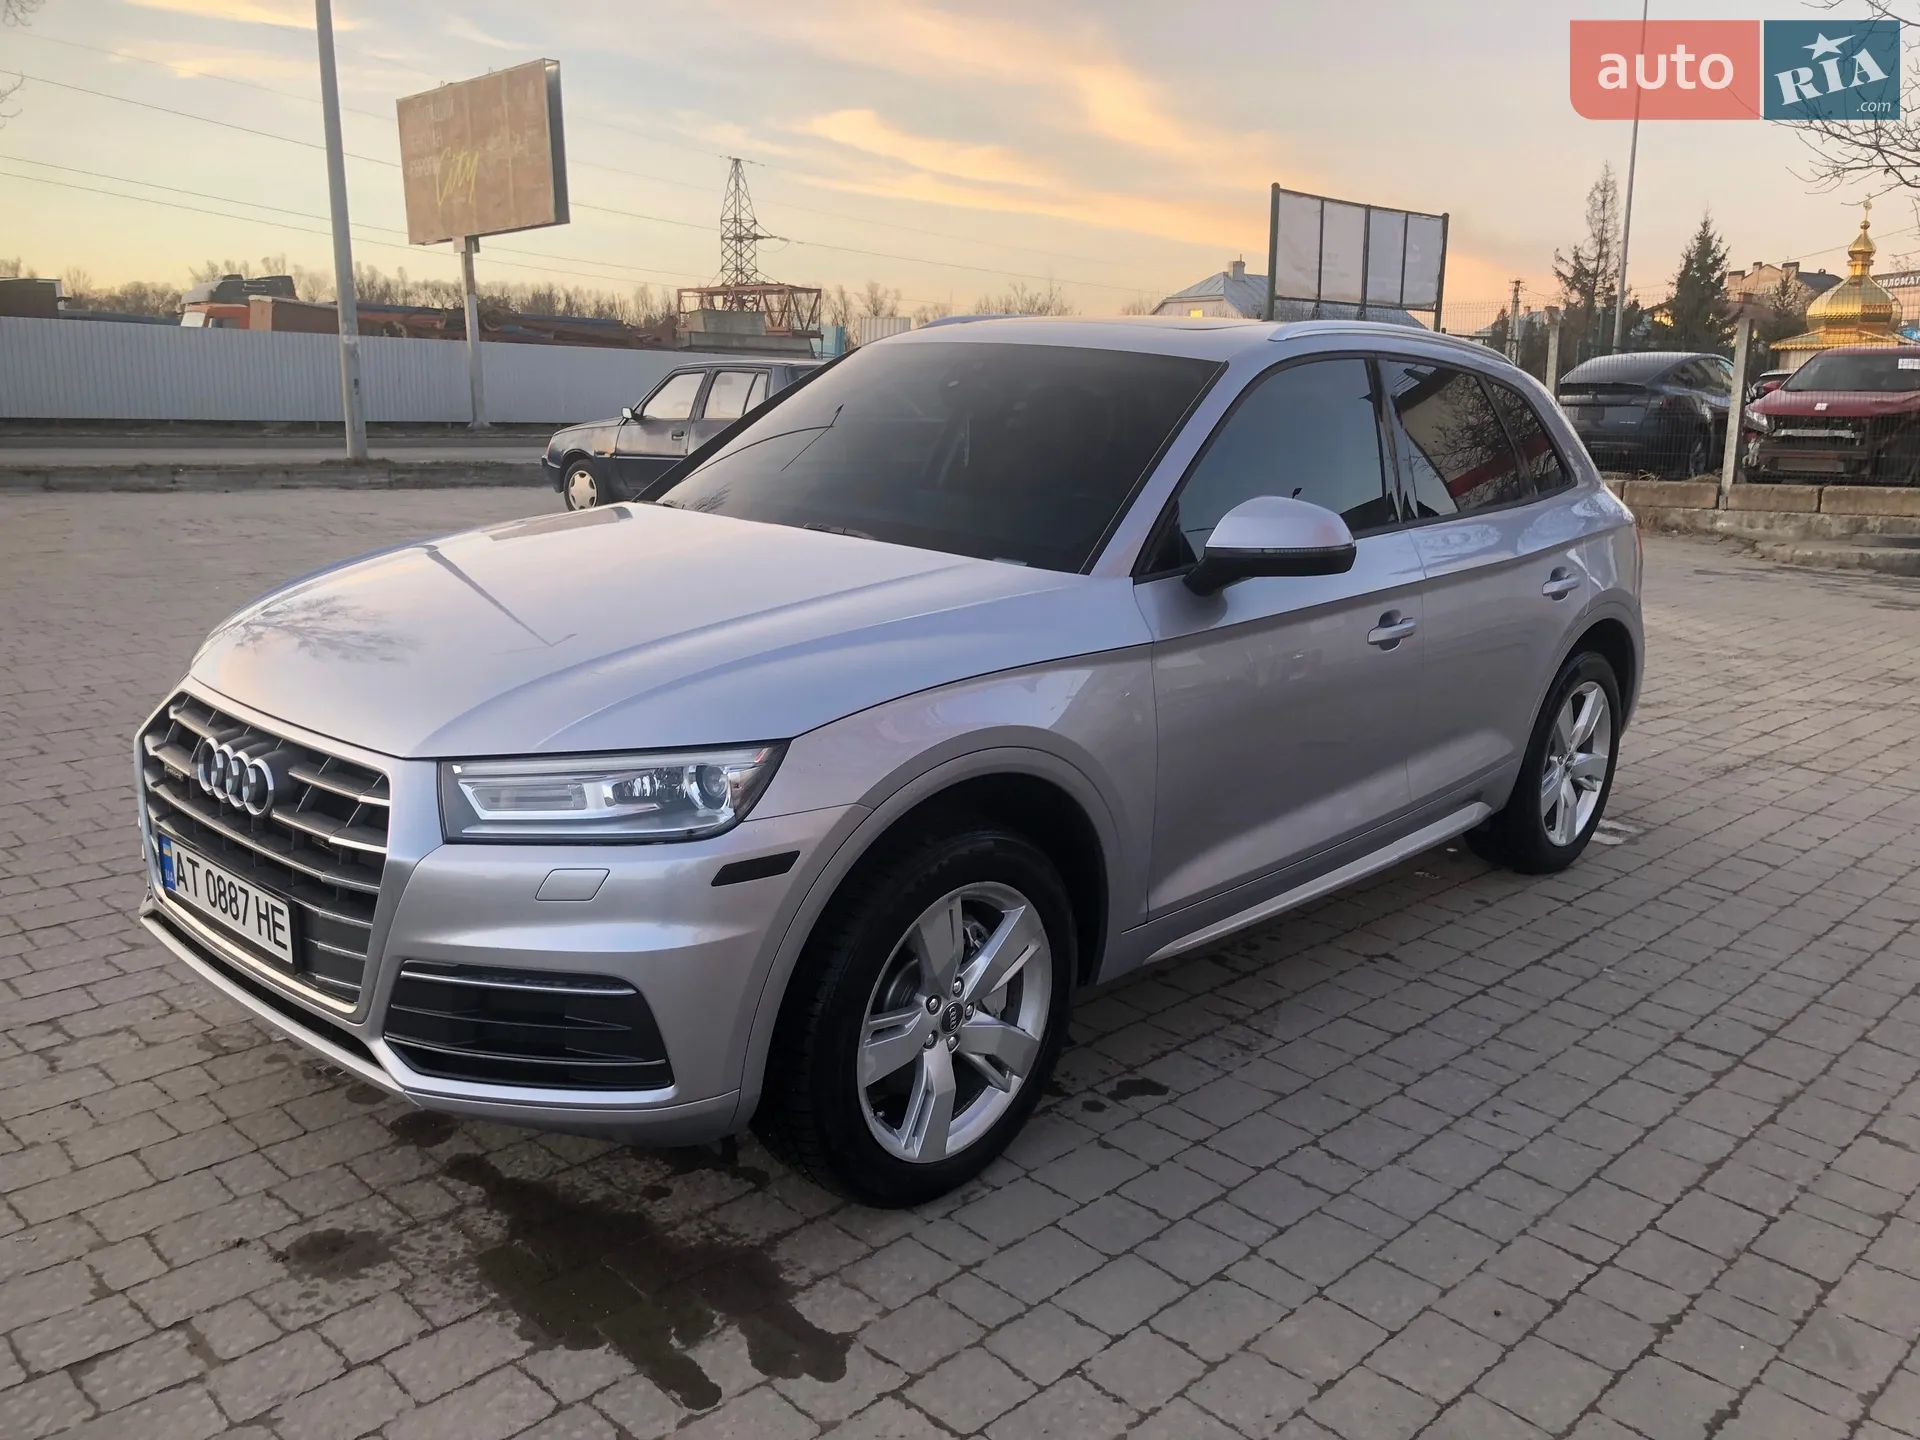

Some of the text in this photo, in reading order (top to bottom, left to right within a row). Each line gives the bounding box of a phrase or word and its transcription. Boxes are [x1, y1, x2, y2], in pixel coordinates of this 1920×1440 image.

[176, 851, 288, 951] AT 0887 HE
